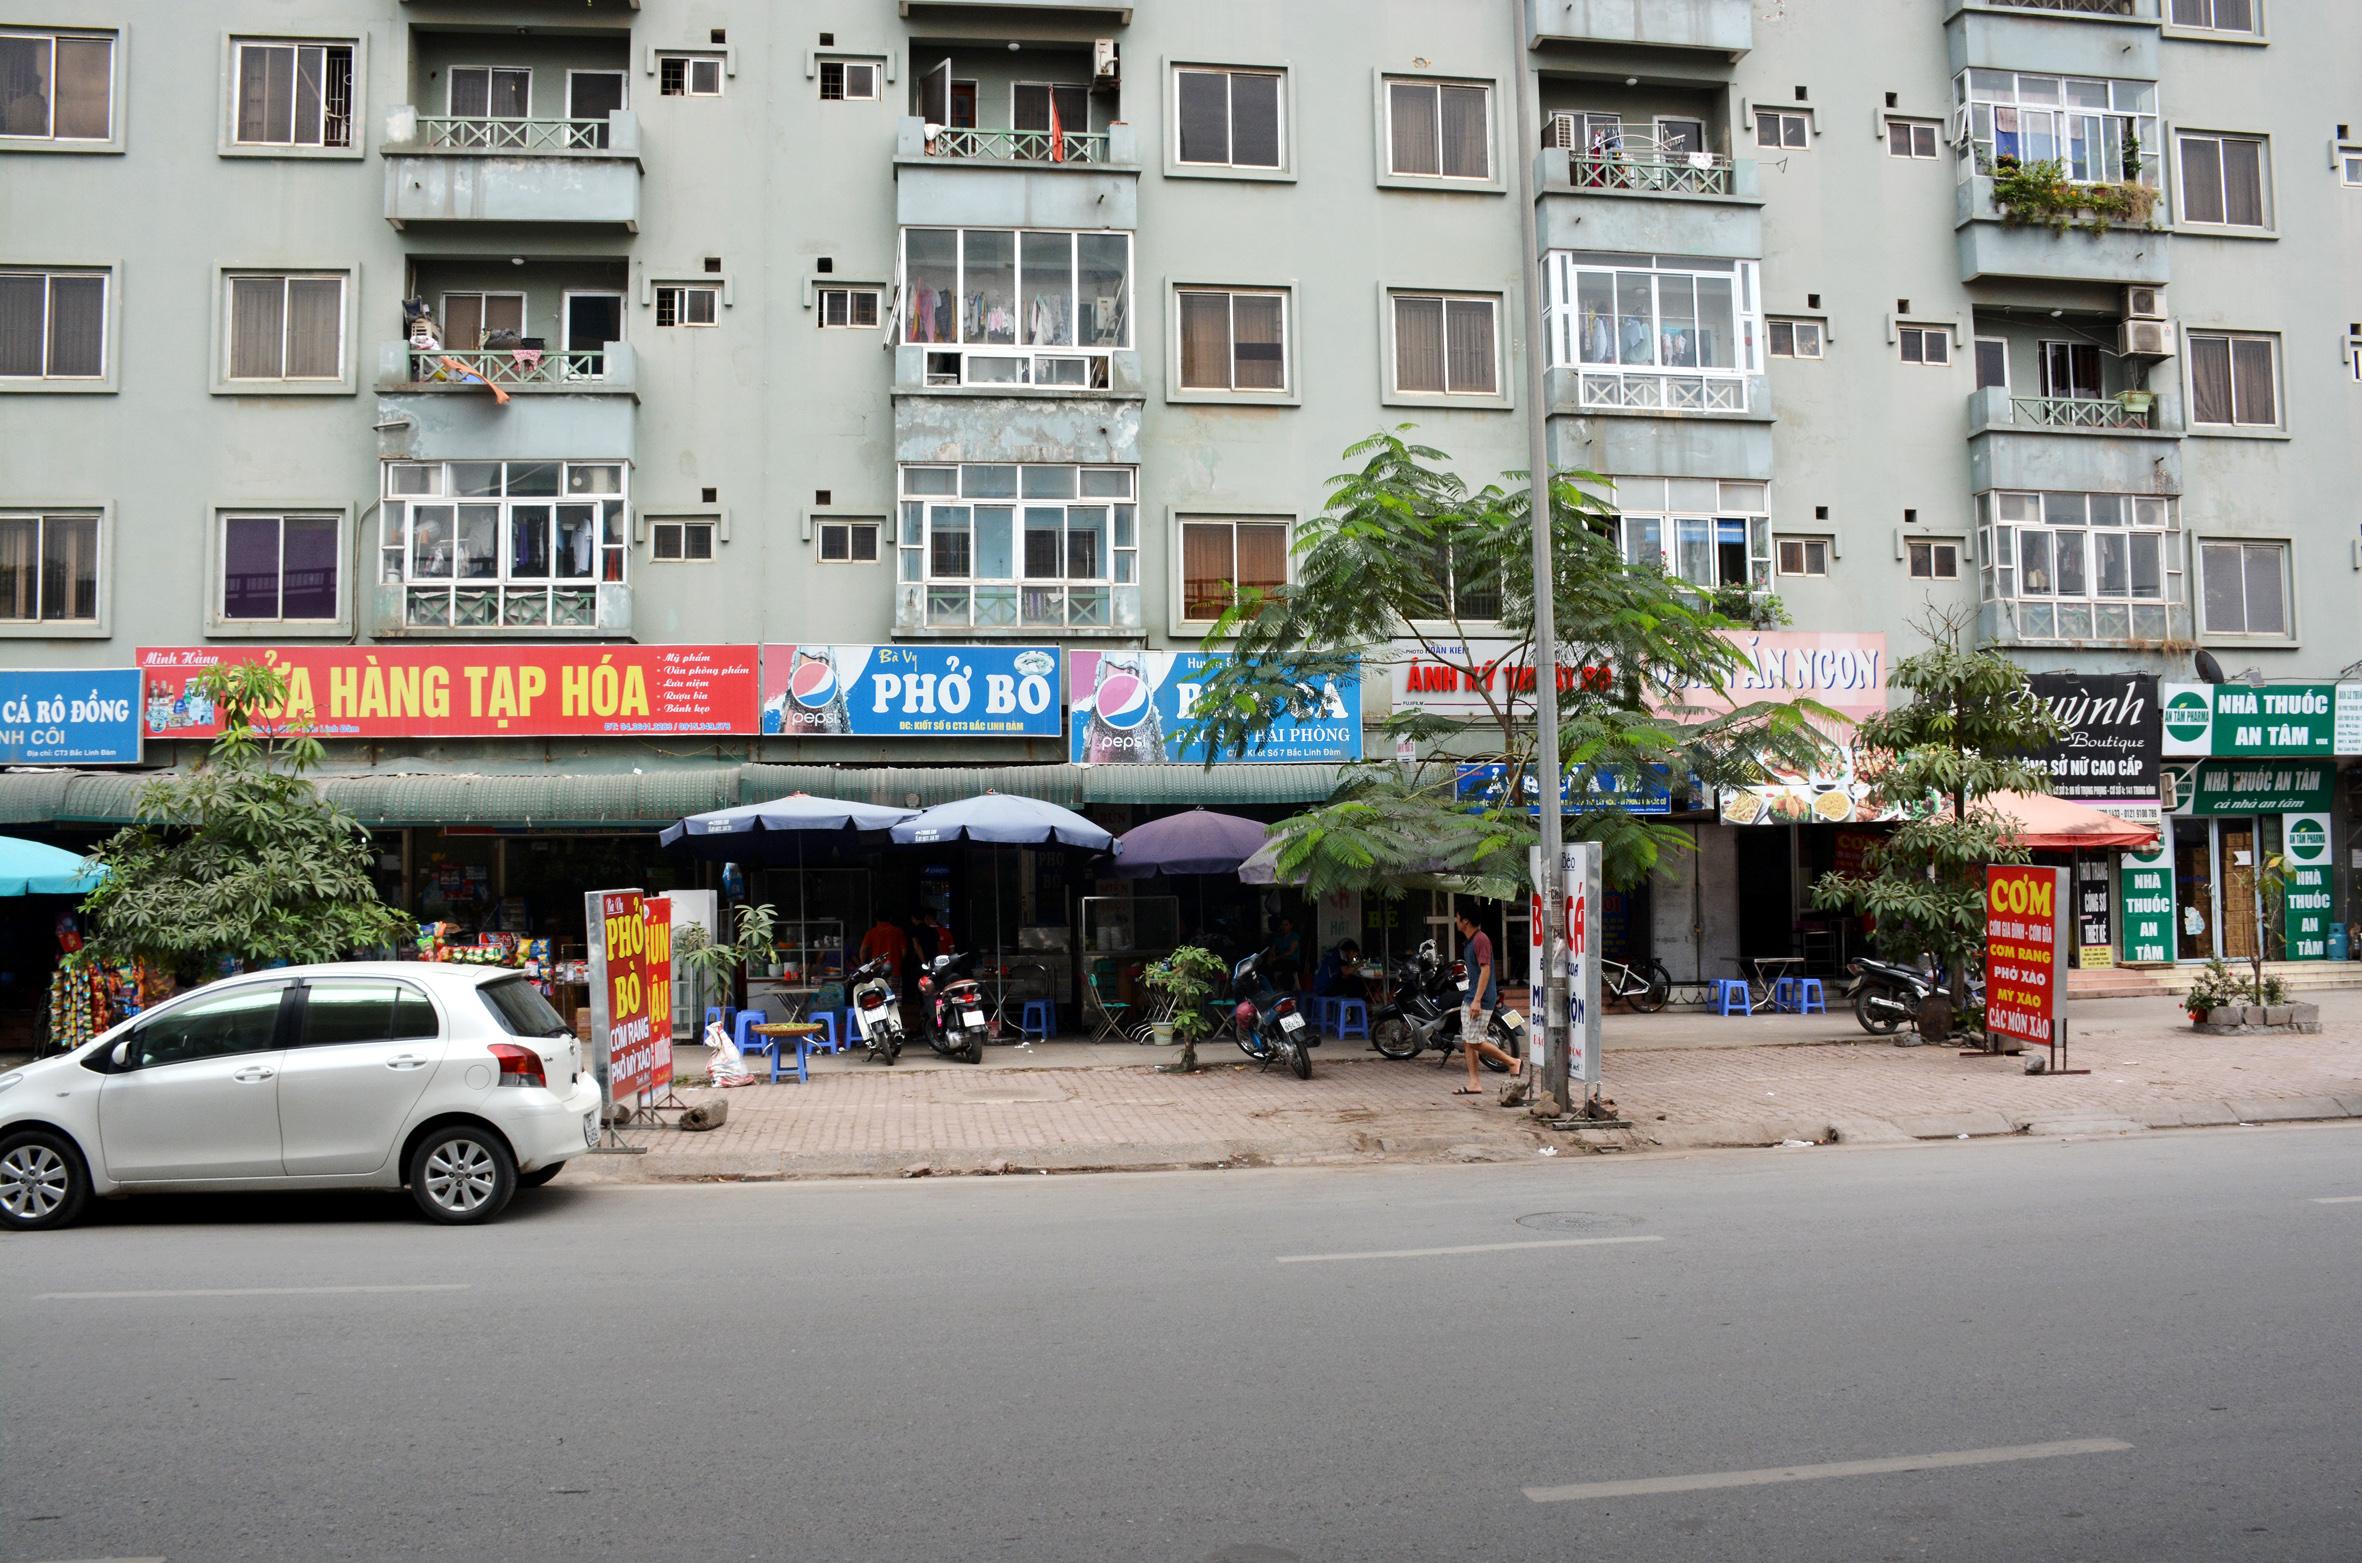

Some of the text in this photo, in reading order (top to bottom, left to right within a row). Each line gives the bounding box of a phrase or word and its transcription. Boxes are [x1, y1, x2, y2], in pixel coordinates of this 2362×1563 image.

[880, 649, 899, 663] Bà
[1743, 635, 1787, 689] ĂN
[872, 655, 973, 714] PHỞ
[1407, 656, 1459, 692] ẢNH
[330, 655, 450, 718] HÀNG
[464, 665, 546, 728] TẠP
[562, 654, 650, 717] HÓA
[2218, 688, 2329, 715] NHÀ THUỐC
[2, 688, 130, 724] CÁ RÔ ĐỒNG
[2187, 710, 2209, 722] PHARMA
[792, 710, 838, 726] pepsi
[1101, 734, 1146, 751] pepsi
[1290, 724, 1350, 743] PHÒNG
[2067, 730, 2146, 753] Boutique
[2235, 723, 2309, 746] AN TÂM
[1303, 747, 1321, 757] Linh
[2050, 753, 2068, 776] SỞ
[2070, 755, 2089, 776] NỮ
[2091, 759, 2116, 776] CAO
[2118, 754, 2144, 776] CẤP
[2204, 764, 2321, 792] NHÀ THUỐC AN TÂM
[2258, 801, 2275, 809] an
[2277, 800, 2305, 808] tâm
[2134, 871, 2162, 889] NHÀ
[2296, 869, 2322, 886] NHÀ
[1990, 873, 2053, 918] CƠM
[2125, 893, 2171, 913] THUỐC
[2288, 889, 2331, 909] THUỐC
[605, 896, 645, 962] PHỞ
[2139, 921, 2158, 937] AN
[2301, 917, 2319, 933] AN
[1990, 943, 2052, 964] CƠM RANG
[2134, 943, 2165, 961] TÂM
[2296, 938, 2324, 956] TÂM
[615, 960, 641, 1020] BÒ
[627, 1015, 650, 1046] RANG
[1988, 1002, 2050, 1040] CÁC MÓN XÀO
